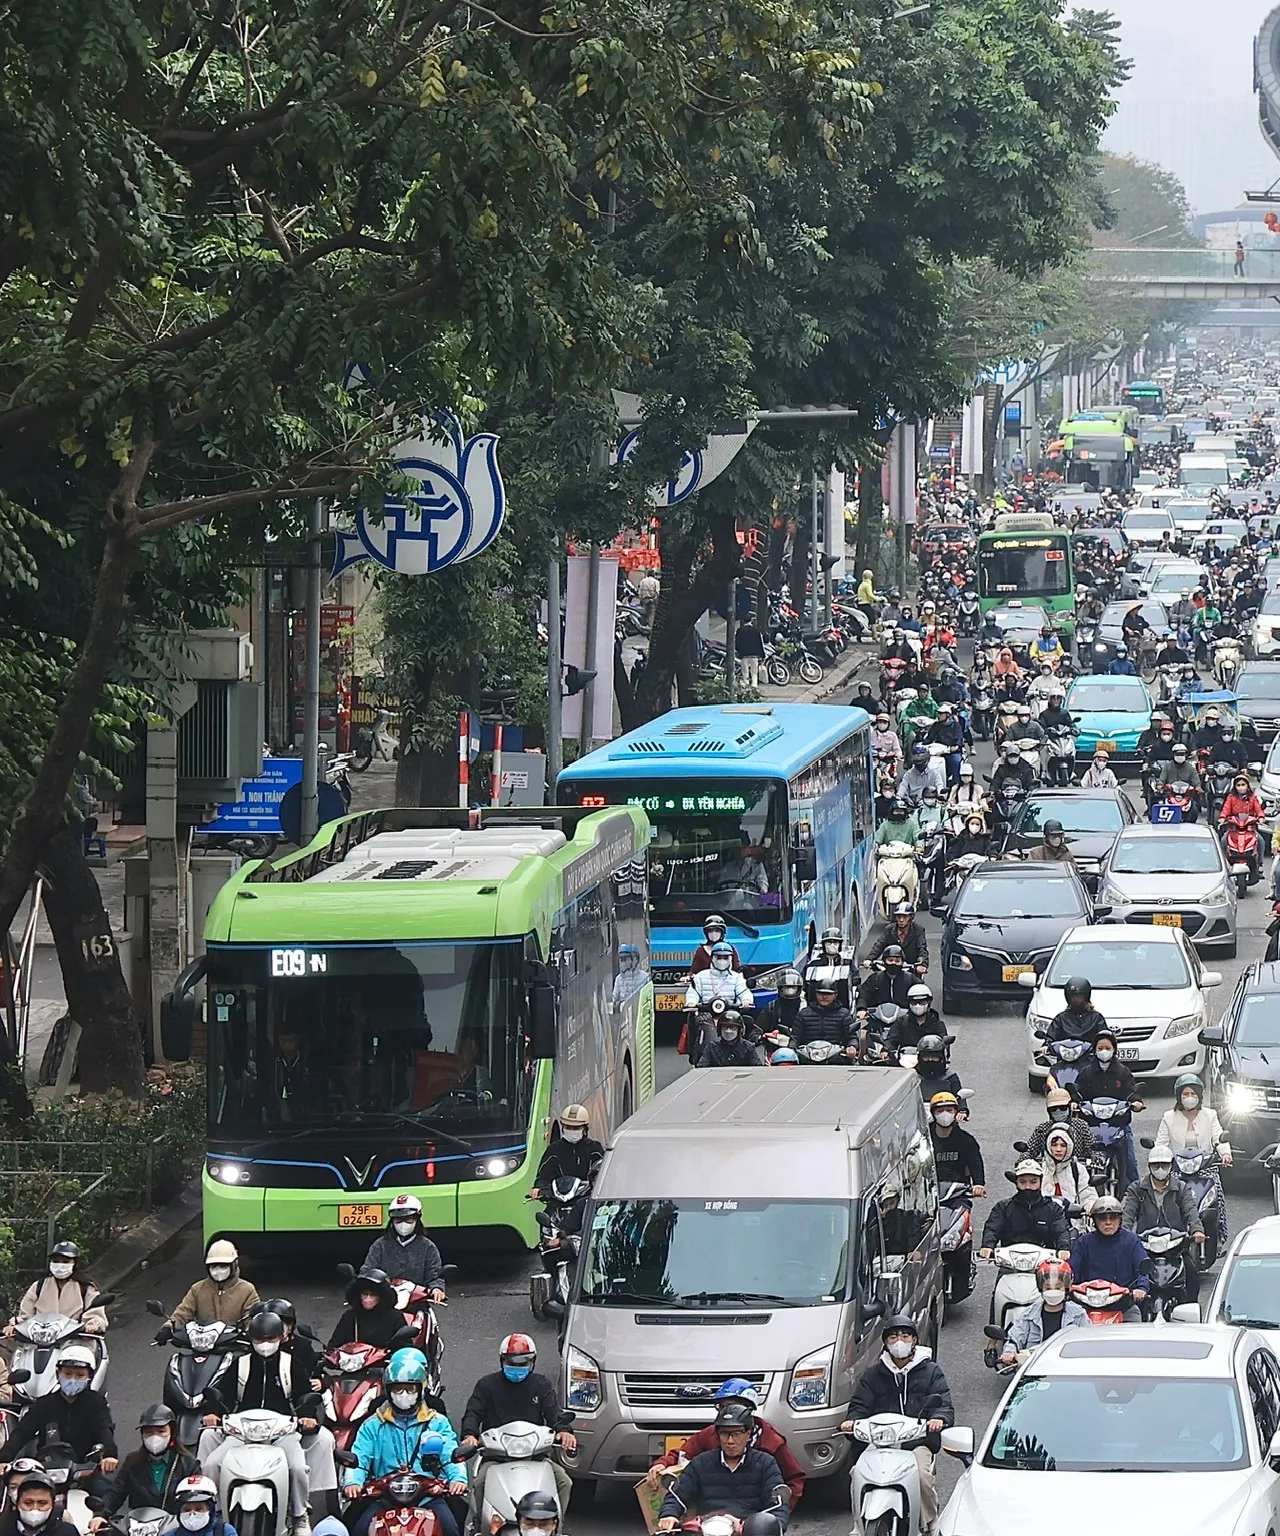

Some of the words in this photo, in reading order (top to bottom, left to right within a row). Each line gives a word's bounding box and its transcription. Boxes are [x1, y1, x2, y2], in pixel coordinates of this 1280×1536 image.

[81, 935, 113, 962] 163
[272, 949, 306, 976] E09
[351, 1206, 370, 1215] 29F
[343, 1215, 378, 1225] 024.59
